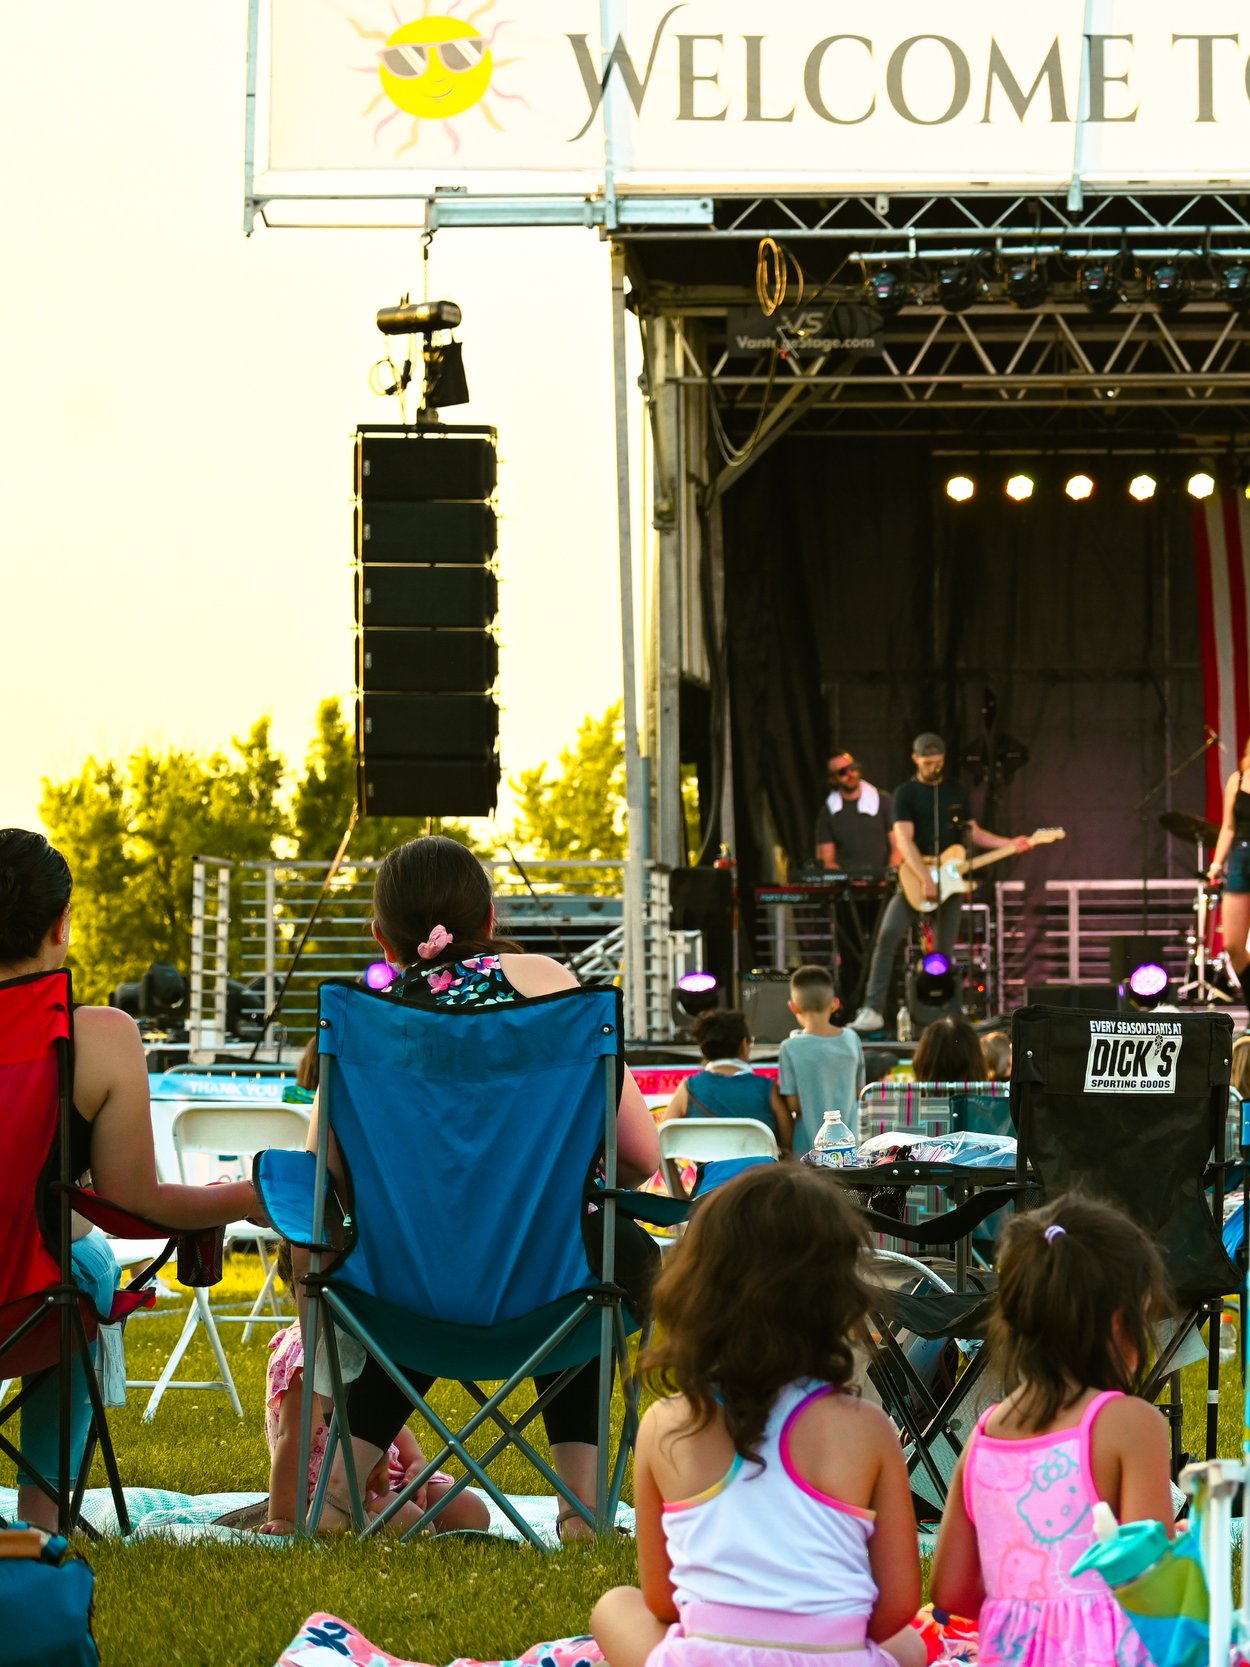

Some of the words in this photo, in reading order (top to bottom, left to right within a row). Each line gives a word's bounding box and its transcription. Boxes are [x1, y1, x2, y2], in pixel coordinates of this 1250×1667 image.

[565, 3, 1140, 143] WELCOME
[1090, 1020, 1116, 1033] EVERY
[1117, 1021, 1147, 1034] SEASON
[1148, 1022, 1172, 1035] STARTS
[1173, 1023, 1182, 1035] AT
[1091, 1036, 1176, 1077] DICK'S
[190, 1082, 241, 1095] THANK
[245, 1084, 278, 1097] YOU
[1091, 1079, 1137, 1089] SPORTING
[1140, 1080, 1170, 1089] GOODS
